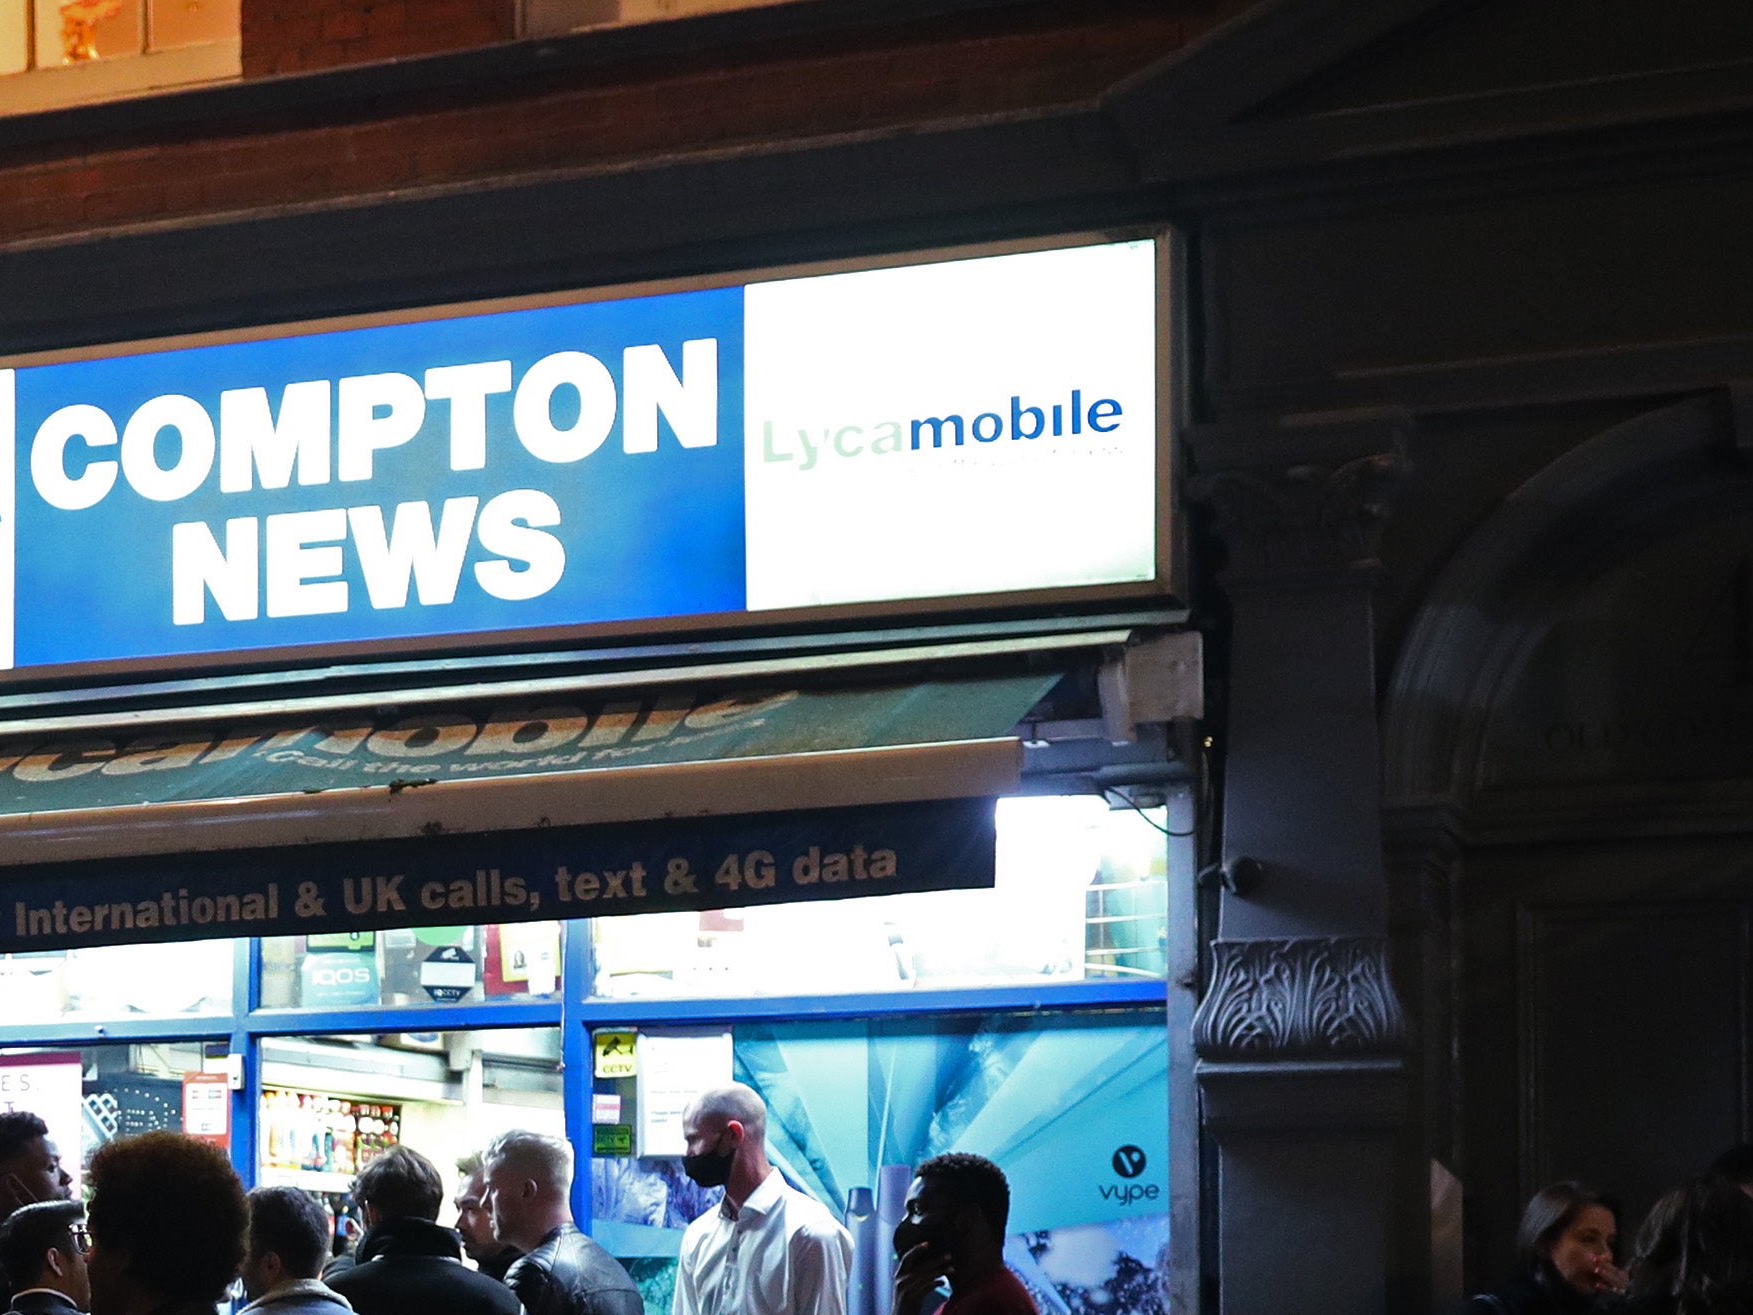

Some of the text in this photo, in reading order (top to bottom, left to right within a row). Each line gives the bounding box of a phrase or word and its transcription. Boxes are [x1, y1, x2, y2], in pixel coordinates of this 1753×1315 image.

[30, 337, 718, 510] COMPTON
[762, 389, 1124, 472] Lycamobile
[172, 489, 566, 626] NEWS
[16, 883, 278, 938] International
[295, 881, 326, 918] &
[344, 873, 406, 915] UK
[421, 867, 540, 914] calls,
[557, 860, 647, 902] text
[664, 857, 698, 895] &
[715, 850, 777, 890] 4G
[793, 842, 898, 885] data
[312, 968, 371, 985] IQOS
[602, 1064, 633, 1074] CCTV
[1098, 1184, 1160, 1207] vype
